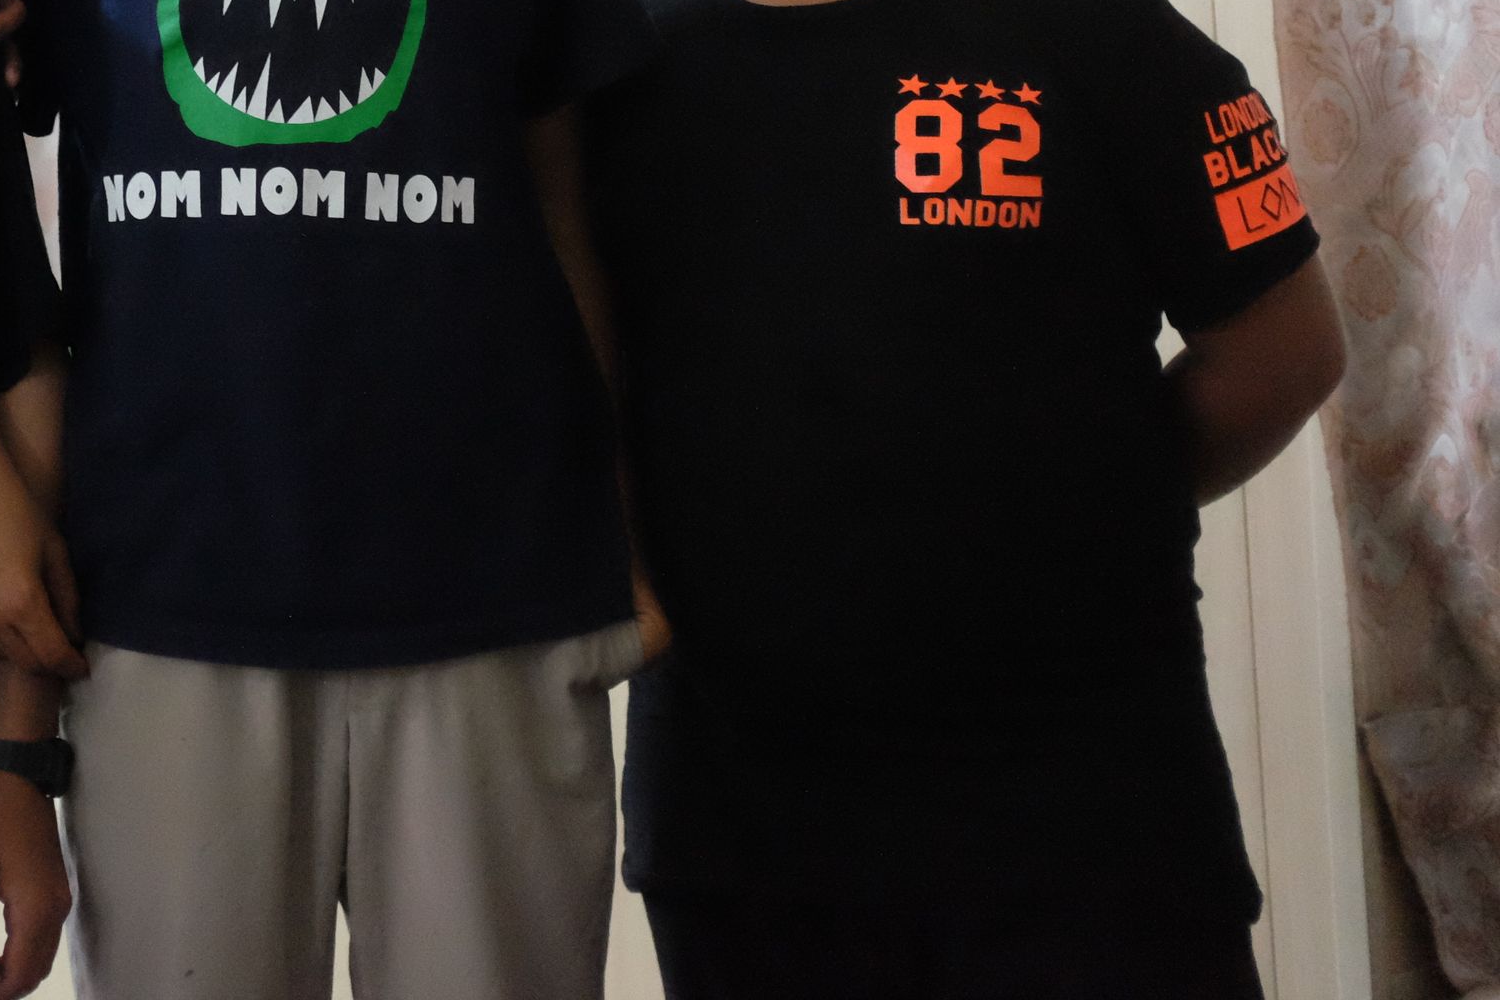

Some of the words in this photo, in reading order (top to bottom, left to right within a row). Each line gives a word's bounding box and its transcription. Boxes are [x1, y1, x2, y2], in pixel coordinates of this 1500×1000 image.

[894, 98, 1043, 198] 82
[1202, 128, 1288, 188] BLAC
[103, 170, 202, 223] NOM
[220, 166, 346, 219] NOM
[364, 172, 476, 225] NOM
[899, 196, 1043, 229] LONDON
